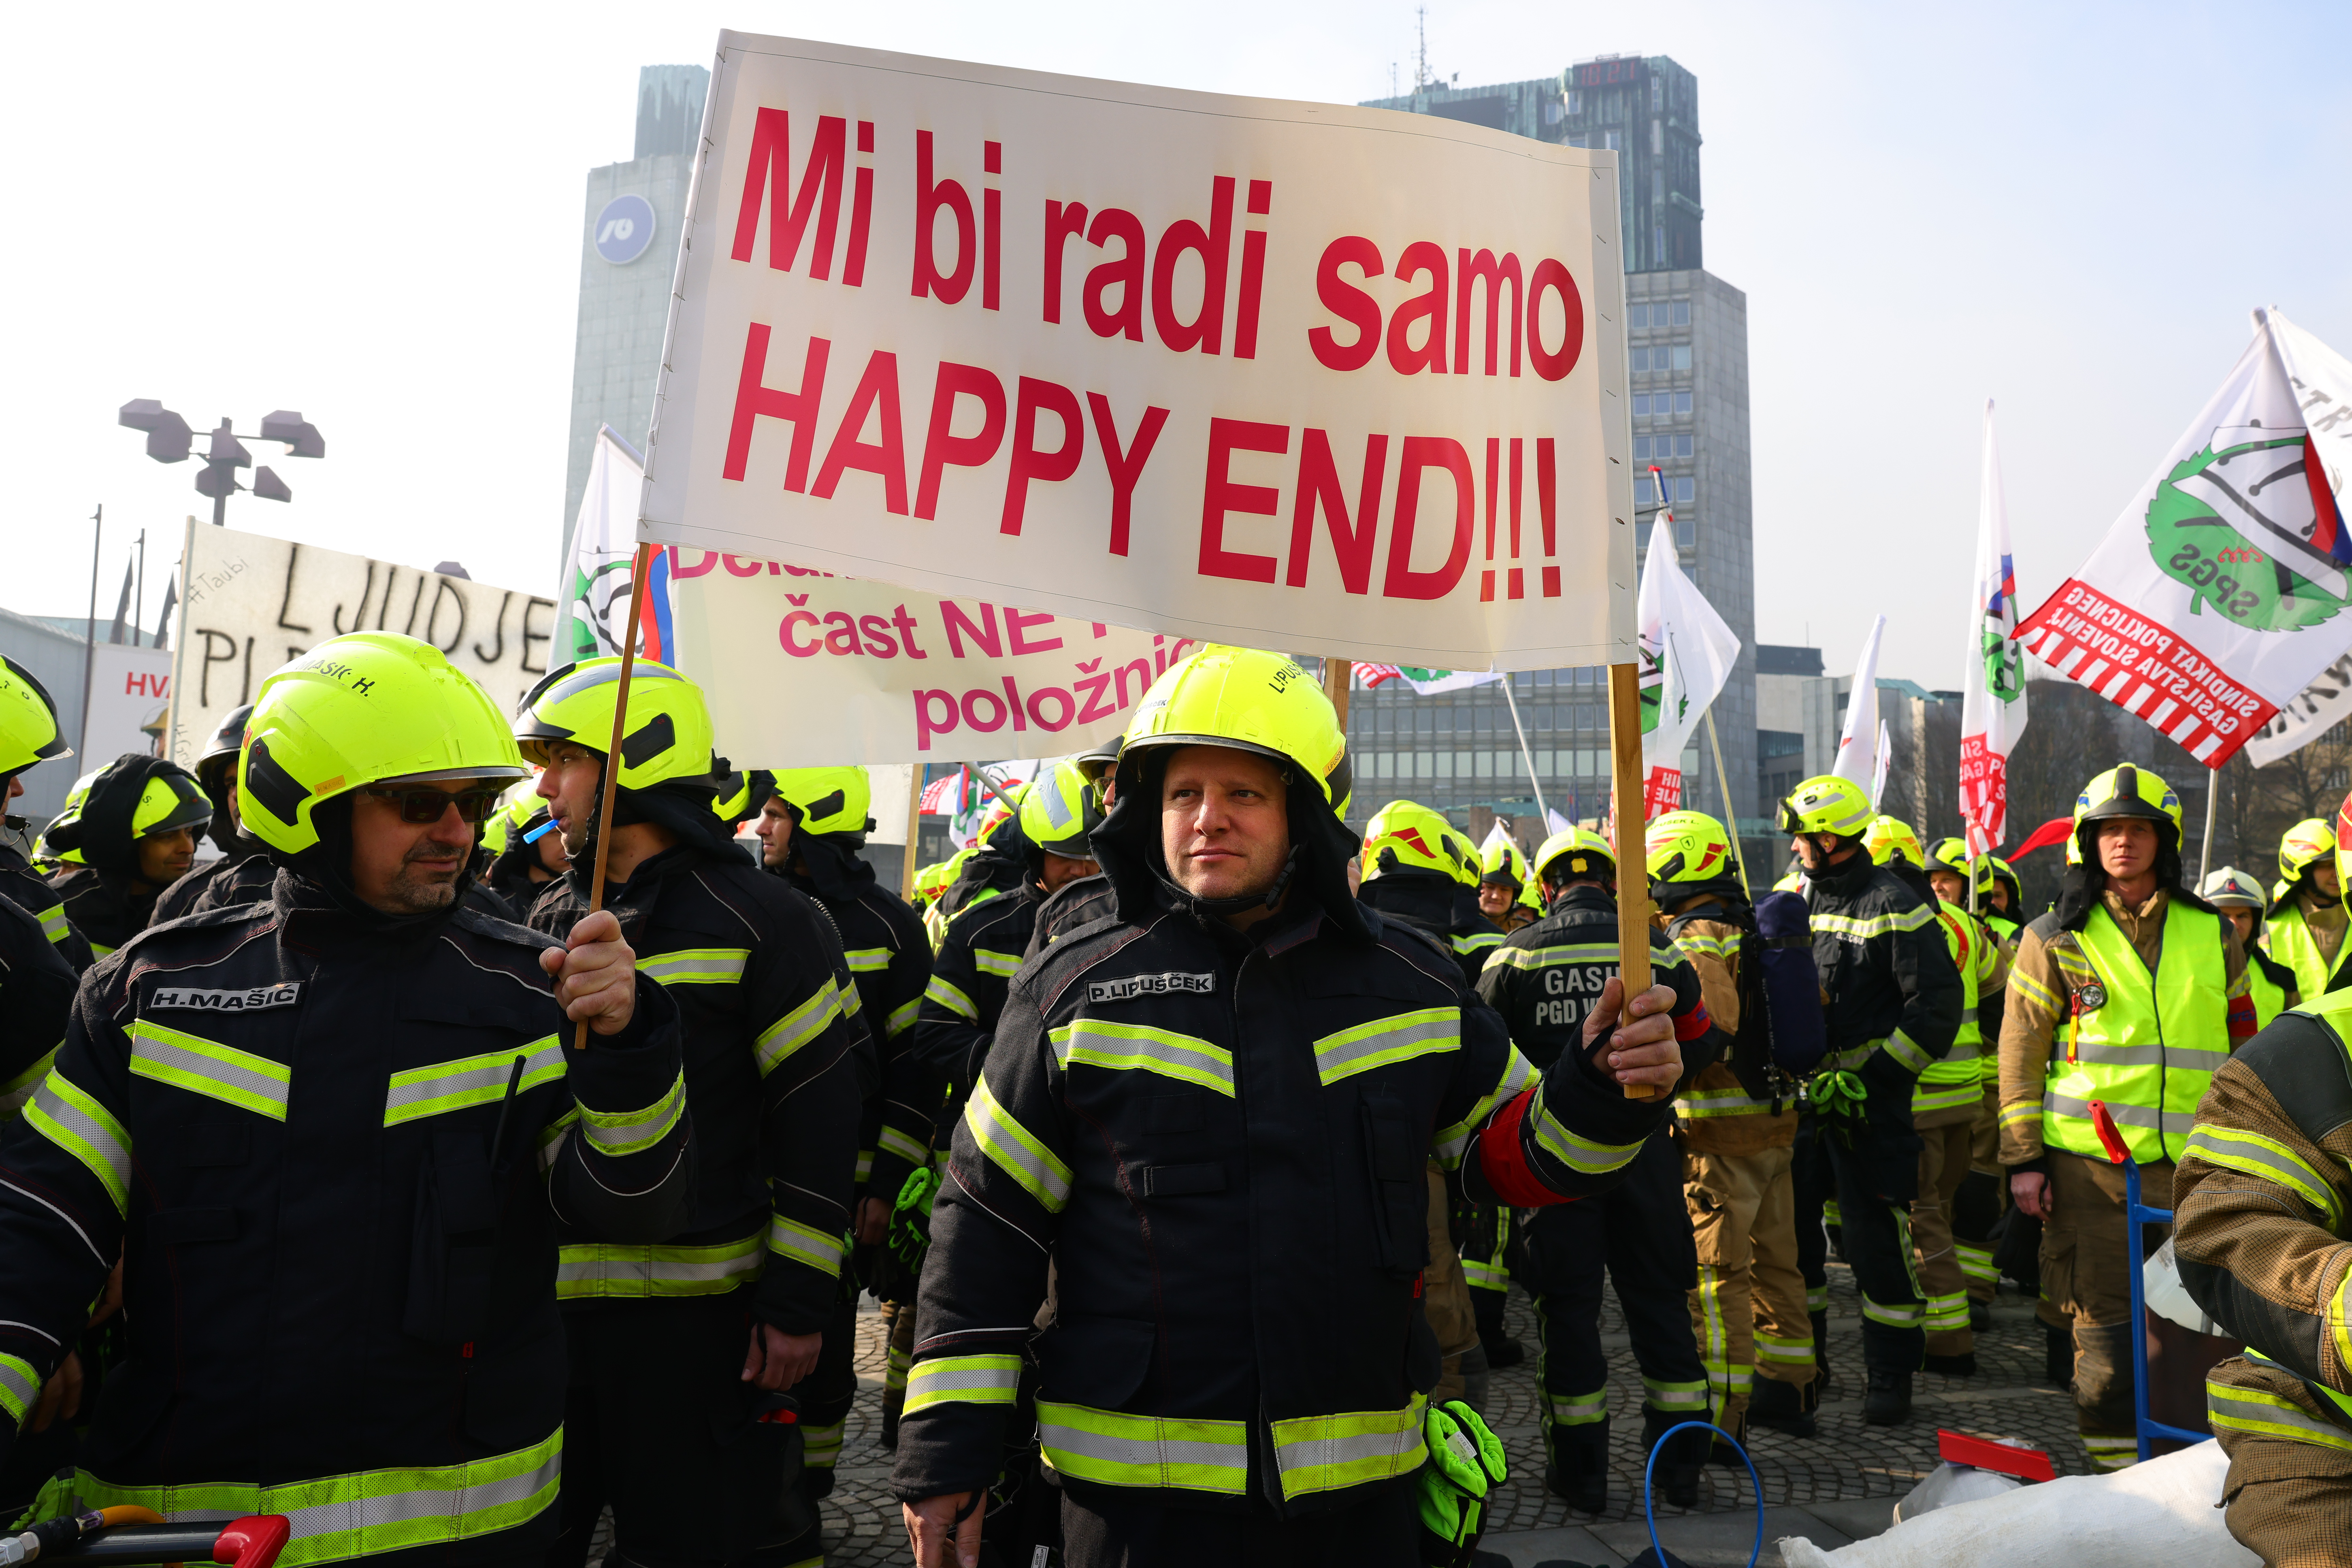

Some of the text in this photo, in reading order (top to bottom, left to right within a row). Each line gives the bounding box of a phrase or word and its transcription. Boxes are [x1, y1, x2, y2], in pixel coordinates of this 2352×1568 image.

[731, 107, 1583, 381] Mi bi radi samo
[723, 322, 1561, 602] HAPPY END!!!
[780, 594, 1063, 660] čast NE
[126, 671, 170, 699] HV
[153, 984, 295, 1009] H.MAŠIĆ
[1091, 973, 1210, 1000] P.LIPUŠČEK
[1536, 999, 1577, 1026] PGD
